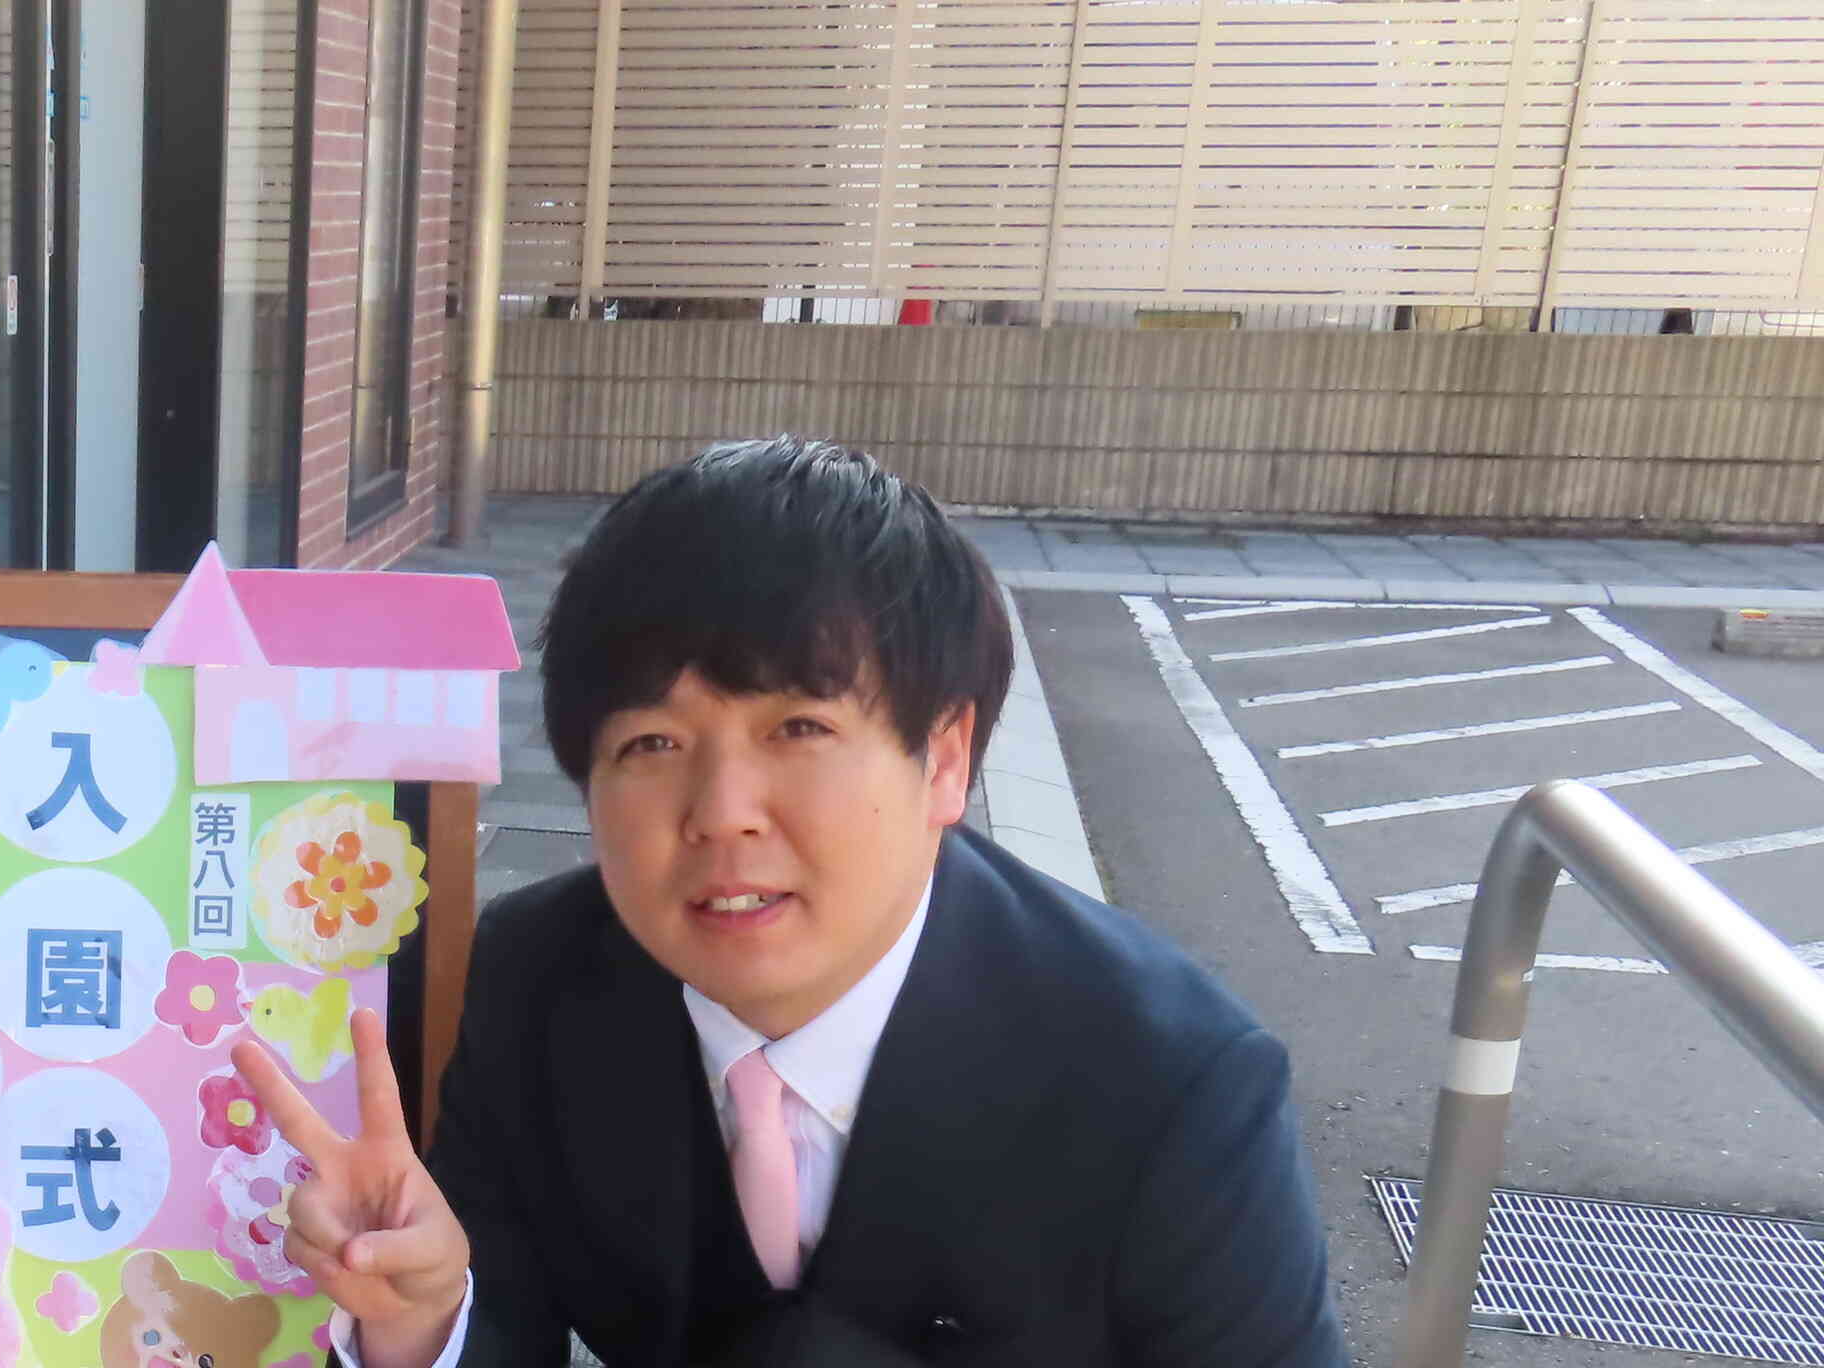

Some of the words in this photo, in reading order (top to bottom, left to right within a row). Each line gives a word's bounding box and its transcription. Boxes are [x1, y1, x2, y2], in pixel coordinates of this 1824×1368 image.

[21, 731, 127, 1232] 入園式
[193, 802, 237, 936] 第八回
